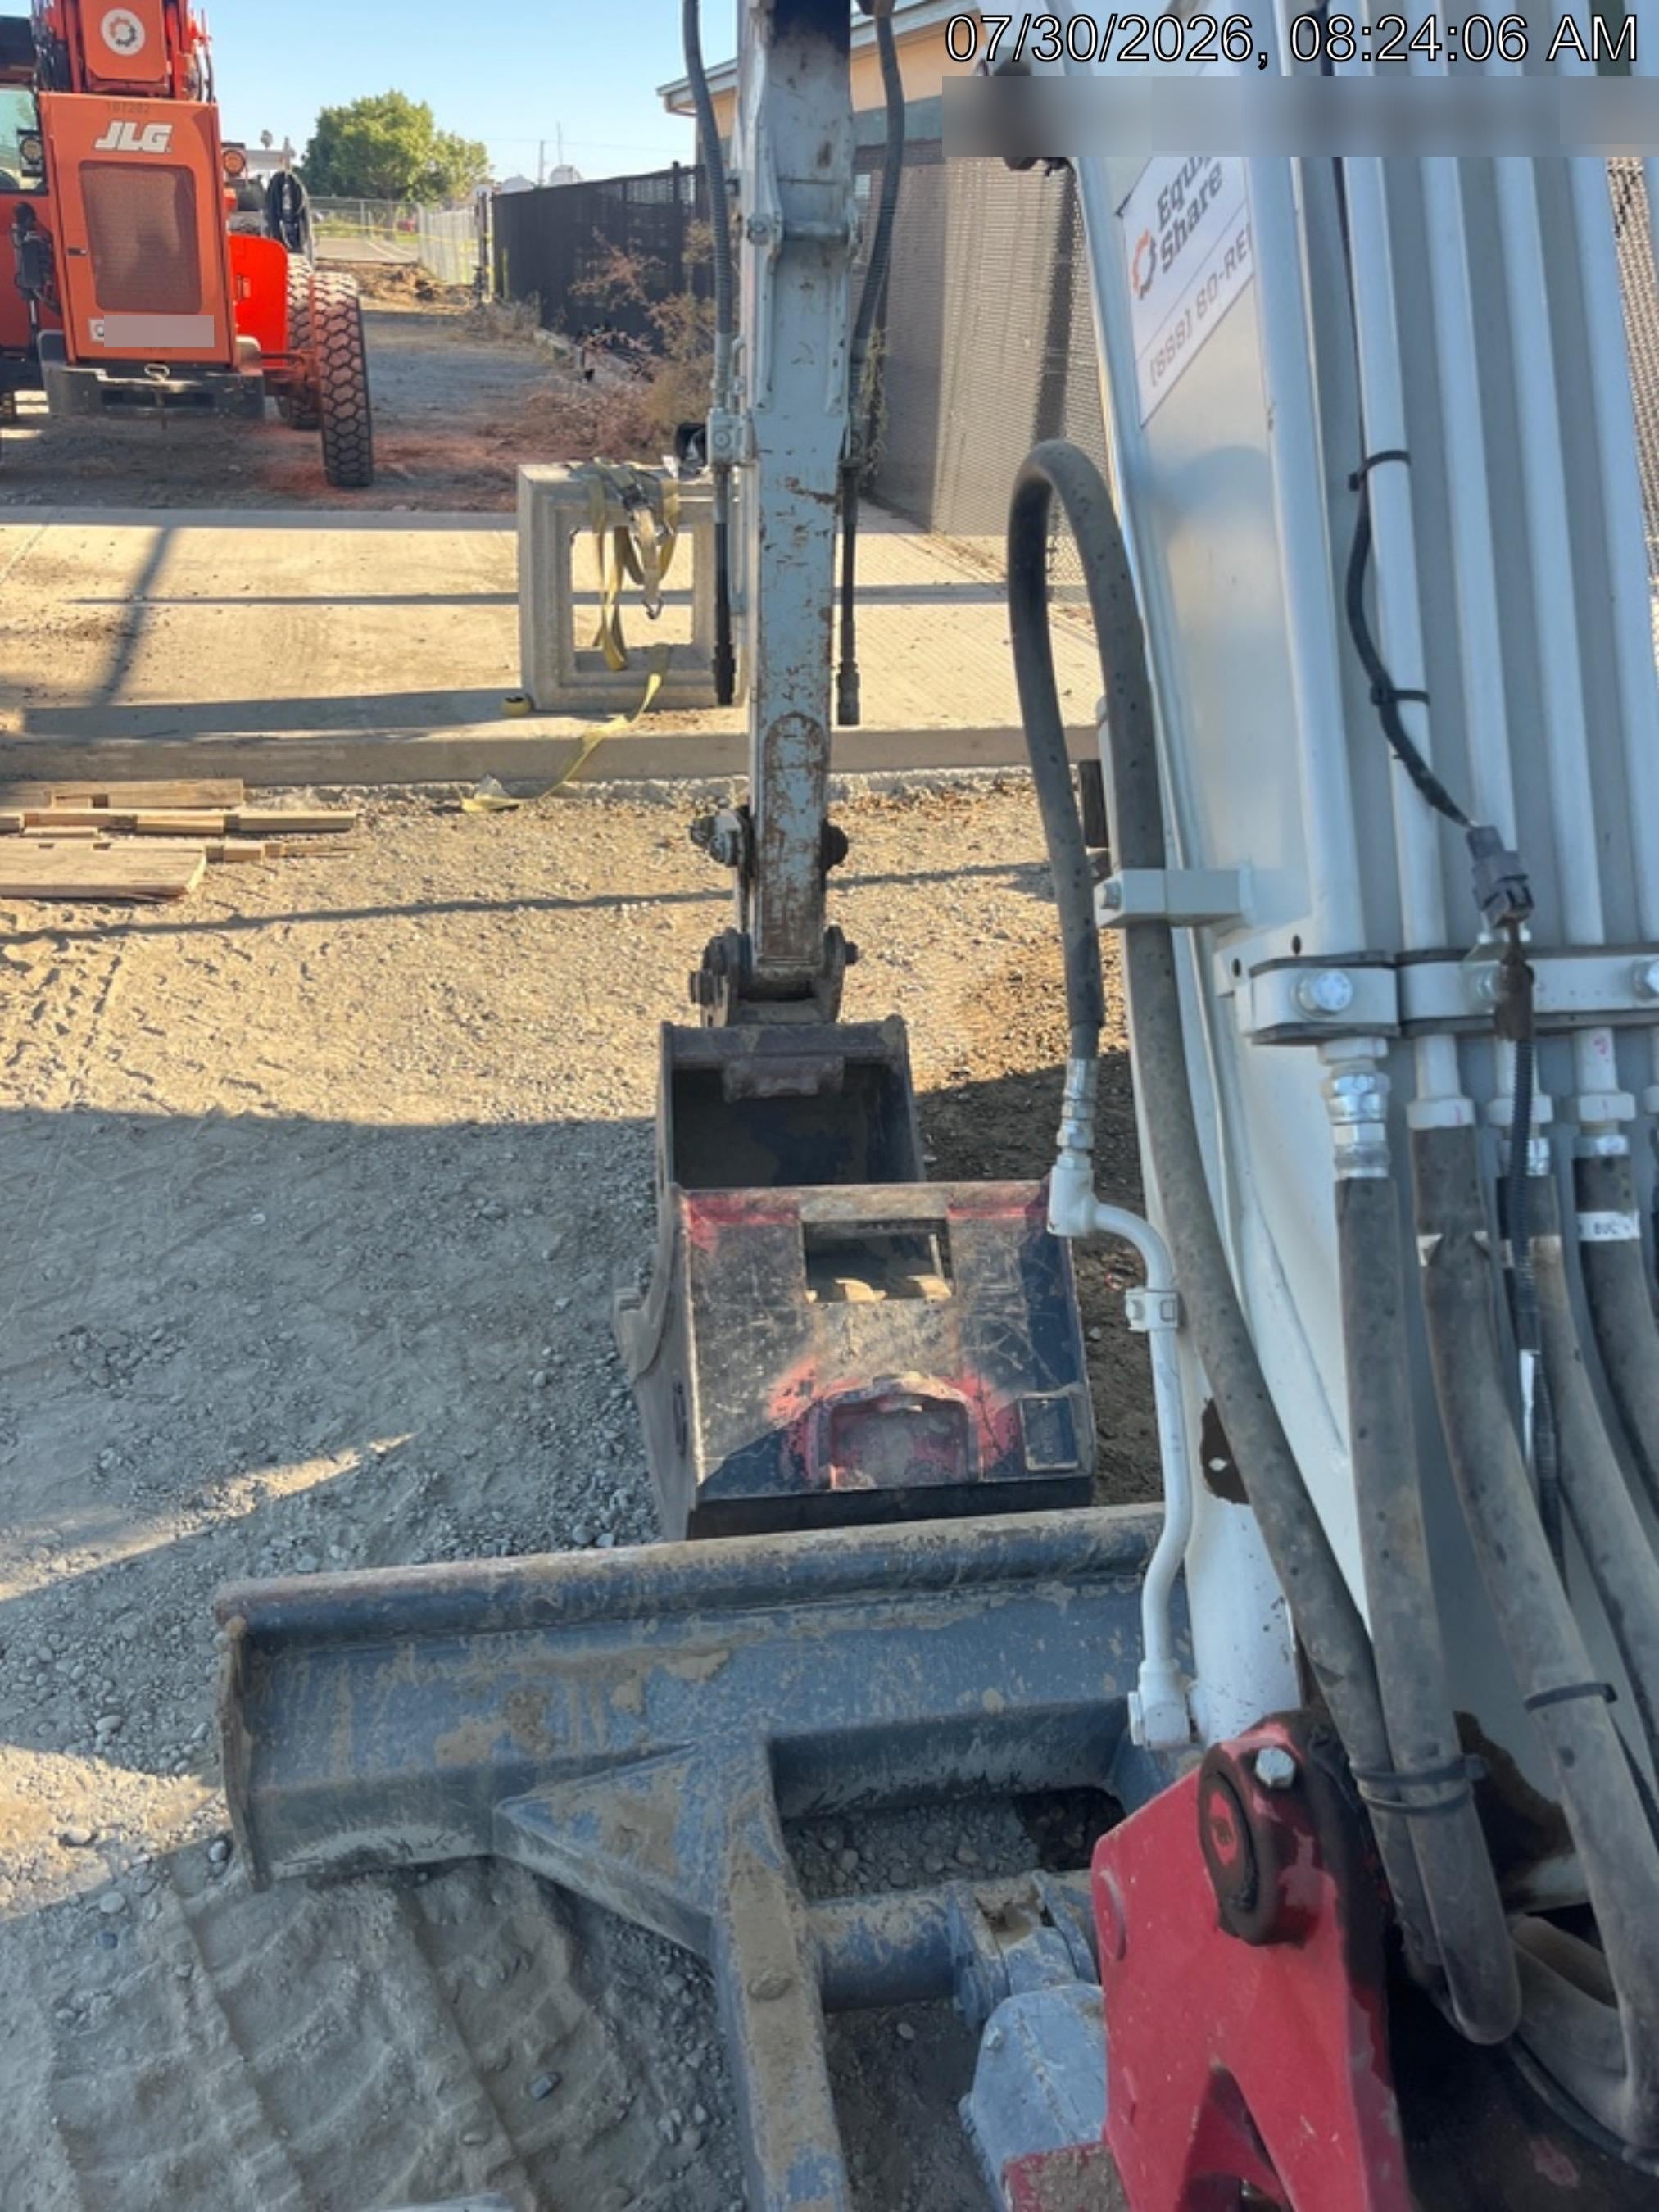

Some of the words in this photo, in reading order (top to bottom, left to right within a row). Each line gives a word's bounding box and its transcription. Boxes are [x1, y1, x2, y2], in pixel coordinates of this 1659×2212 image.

[94, 120, 173, 153] JLG
[1157, 156, 1211, 233] Equ
[1160, 162, 1222, 274] Share
